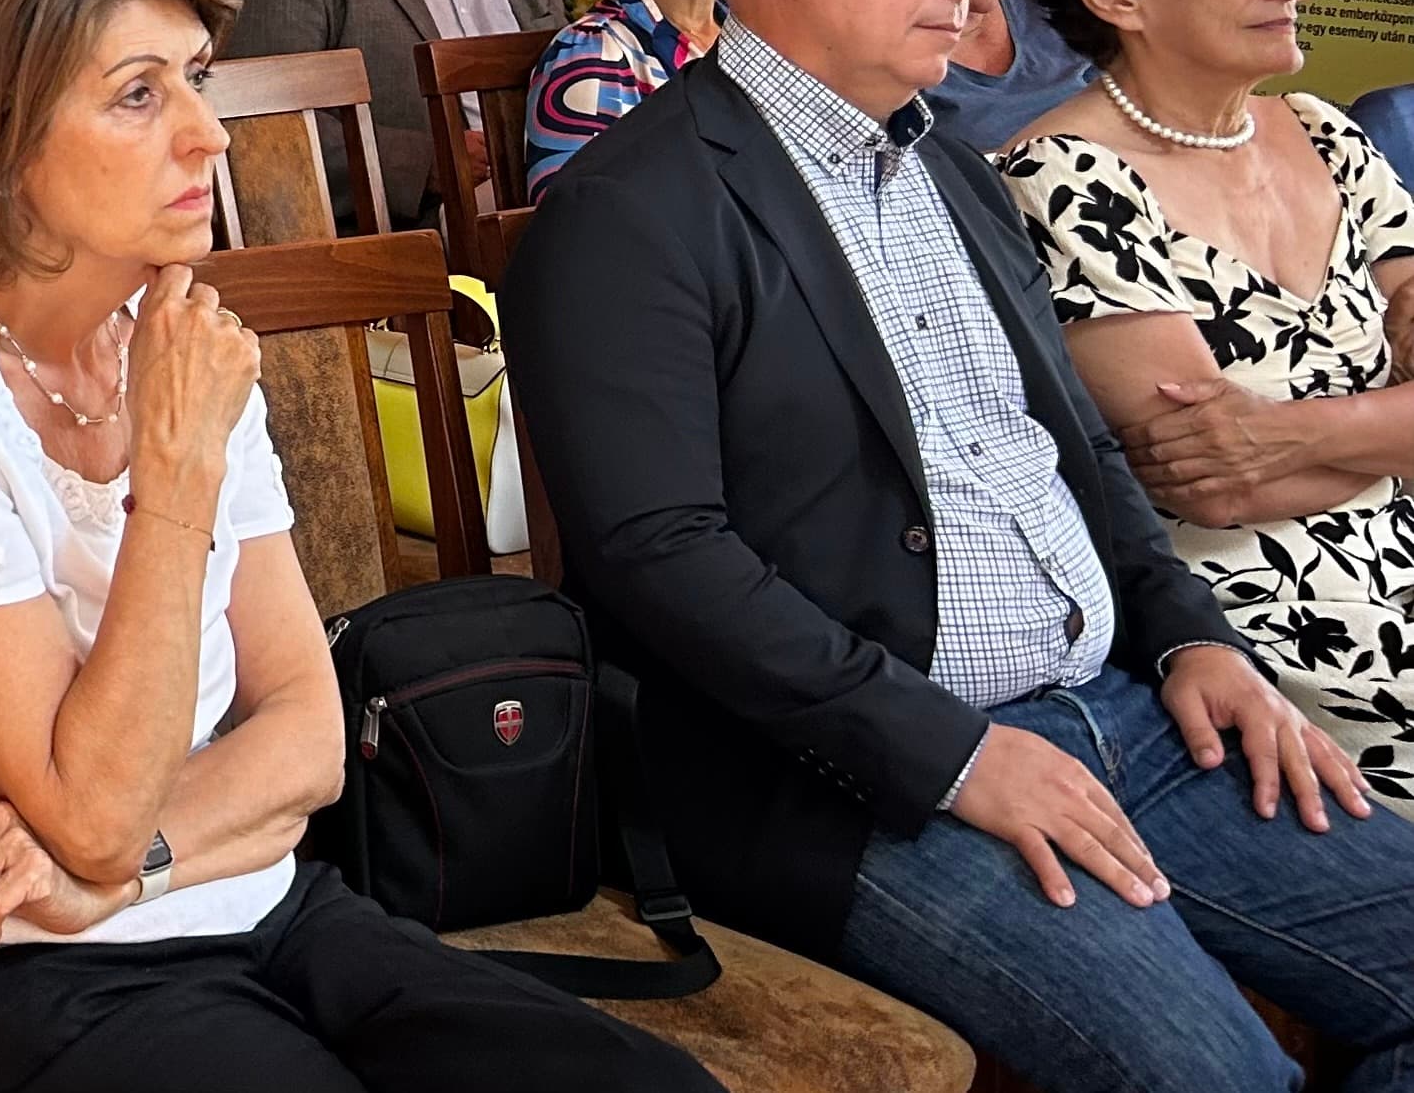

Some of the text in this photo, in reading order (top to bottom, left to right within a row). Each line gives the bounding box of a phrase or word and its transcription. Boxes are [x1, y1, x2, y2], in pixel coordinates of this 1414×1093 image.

[1309, 3, 1322, 15] és
[1324, 7, 1337, 17] az
[1328, 26, 1378, 42] esemény
[1380, 30, 1406, 43] után
